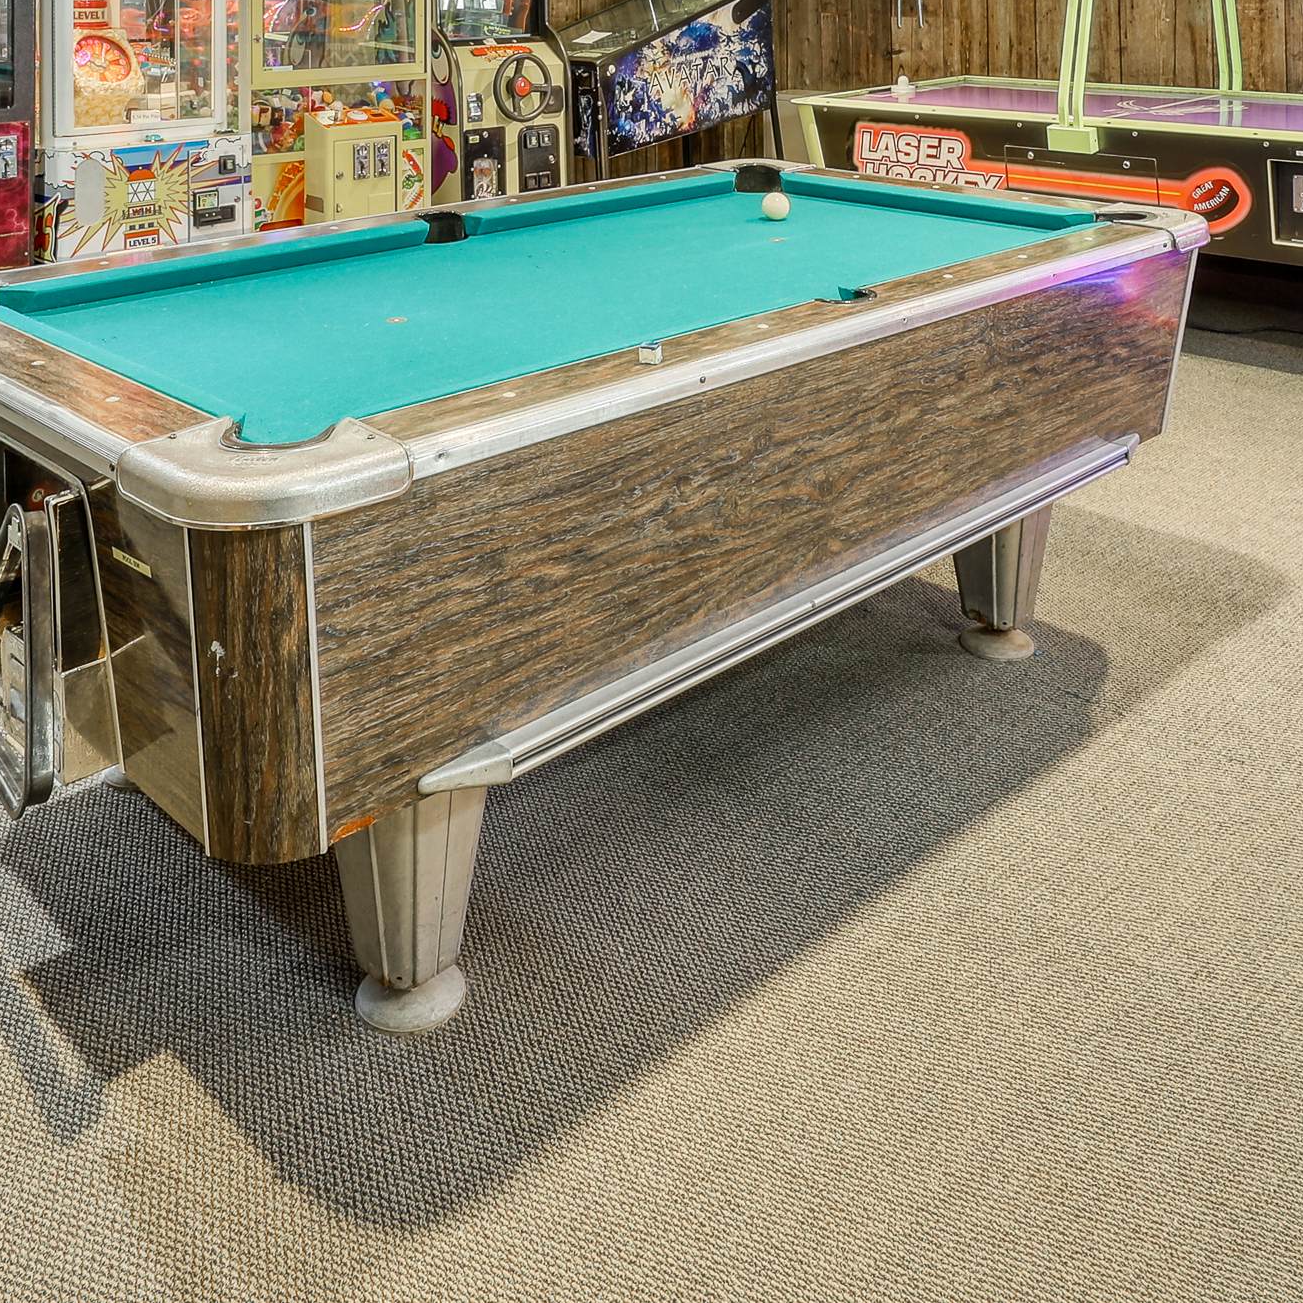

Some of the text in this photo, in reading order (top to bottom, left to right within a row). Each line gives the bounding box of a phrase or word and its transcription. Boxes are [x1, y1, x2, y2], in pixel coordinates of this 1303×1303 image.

[649, 57, 733, 94] AVATAR
[860, 130, 965, 171] LASER
[1192, 180, 1214, 199] GREAT
[1193, 185, 1231, 211] AMERICAN
[131, 205, 153, 216] WIN
[129, 236, 157, 247] LEVEL 5
